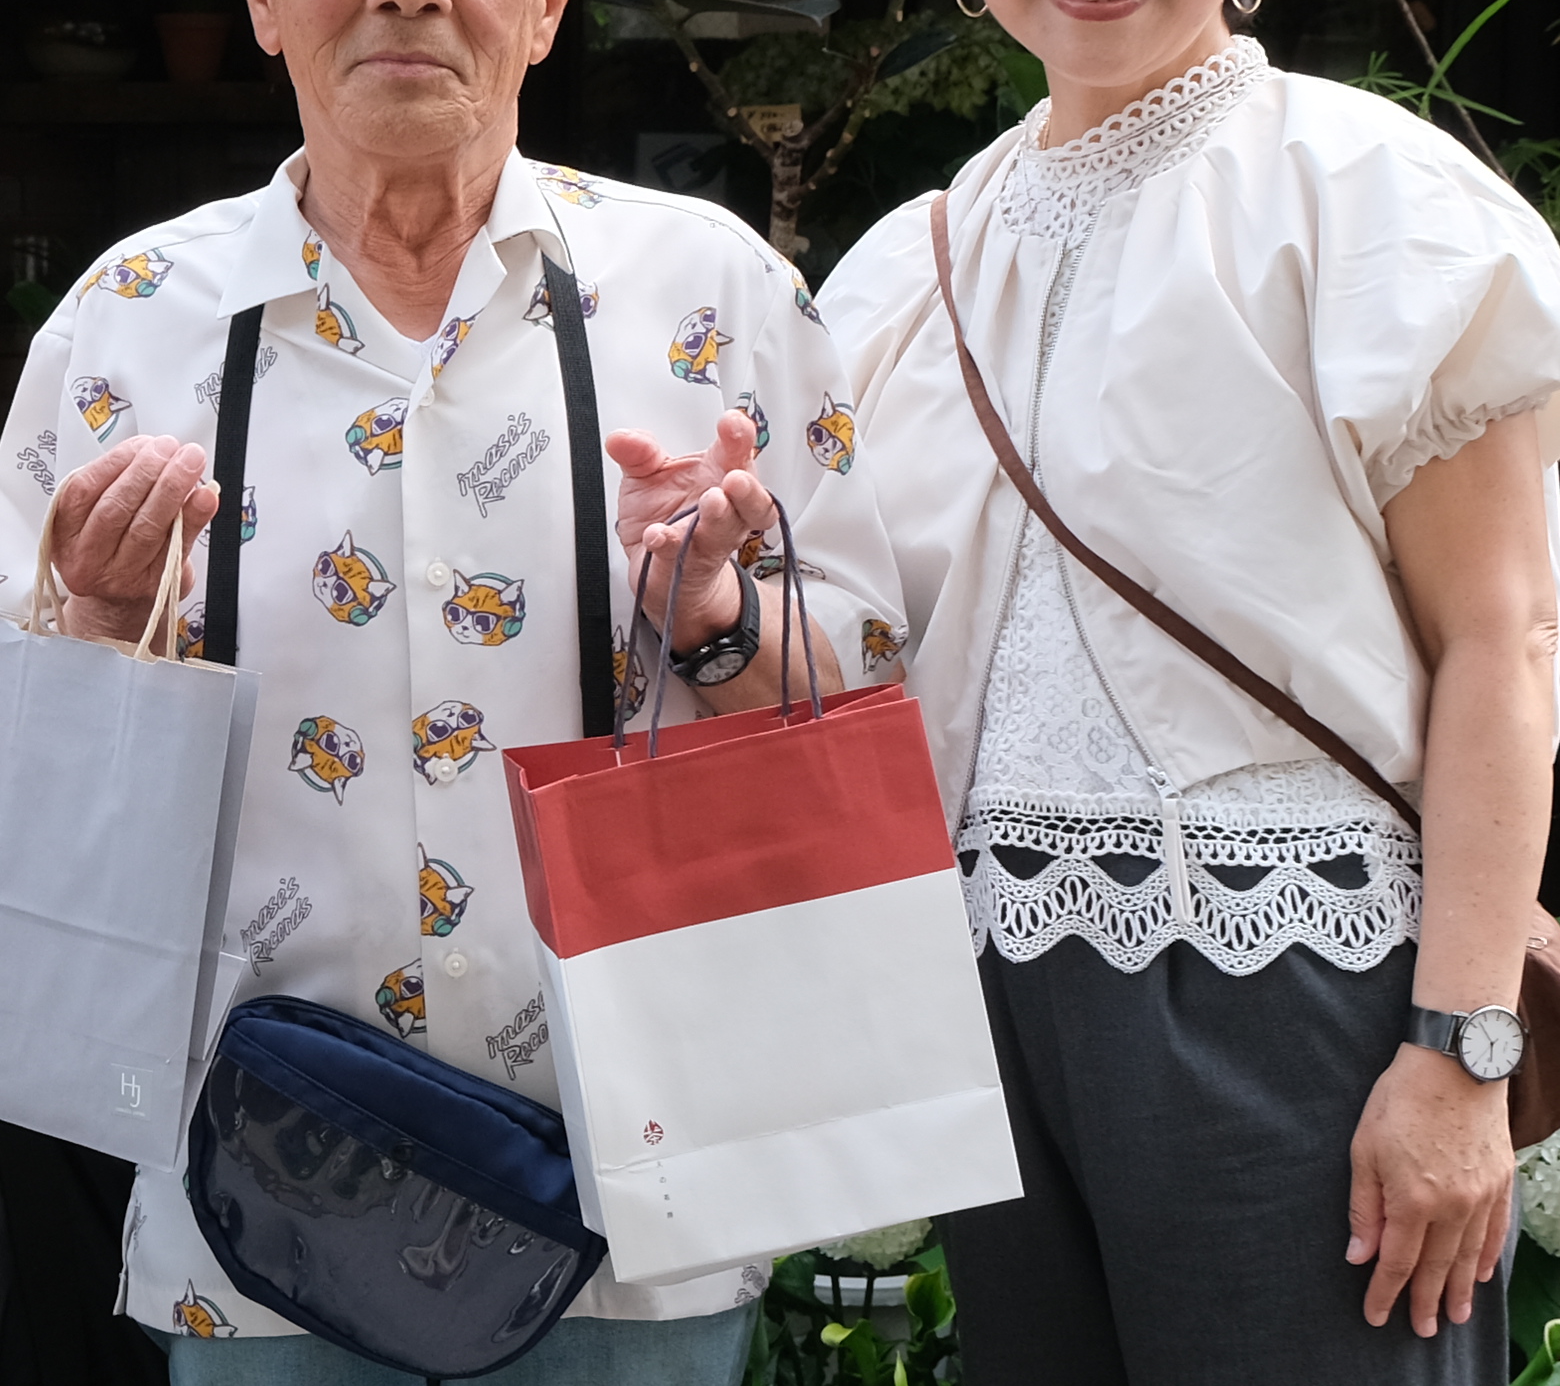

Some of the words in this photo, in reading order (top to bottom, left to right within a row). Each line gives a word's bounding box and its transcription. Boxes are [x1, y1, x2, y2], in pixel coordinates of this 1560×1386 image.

[473, 429, 550, 518] Records
[249, 896, 313, 978] Records
[502, 1022, 550, 1081] Reco
